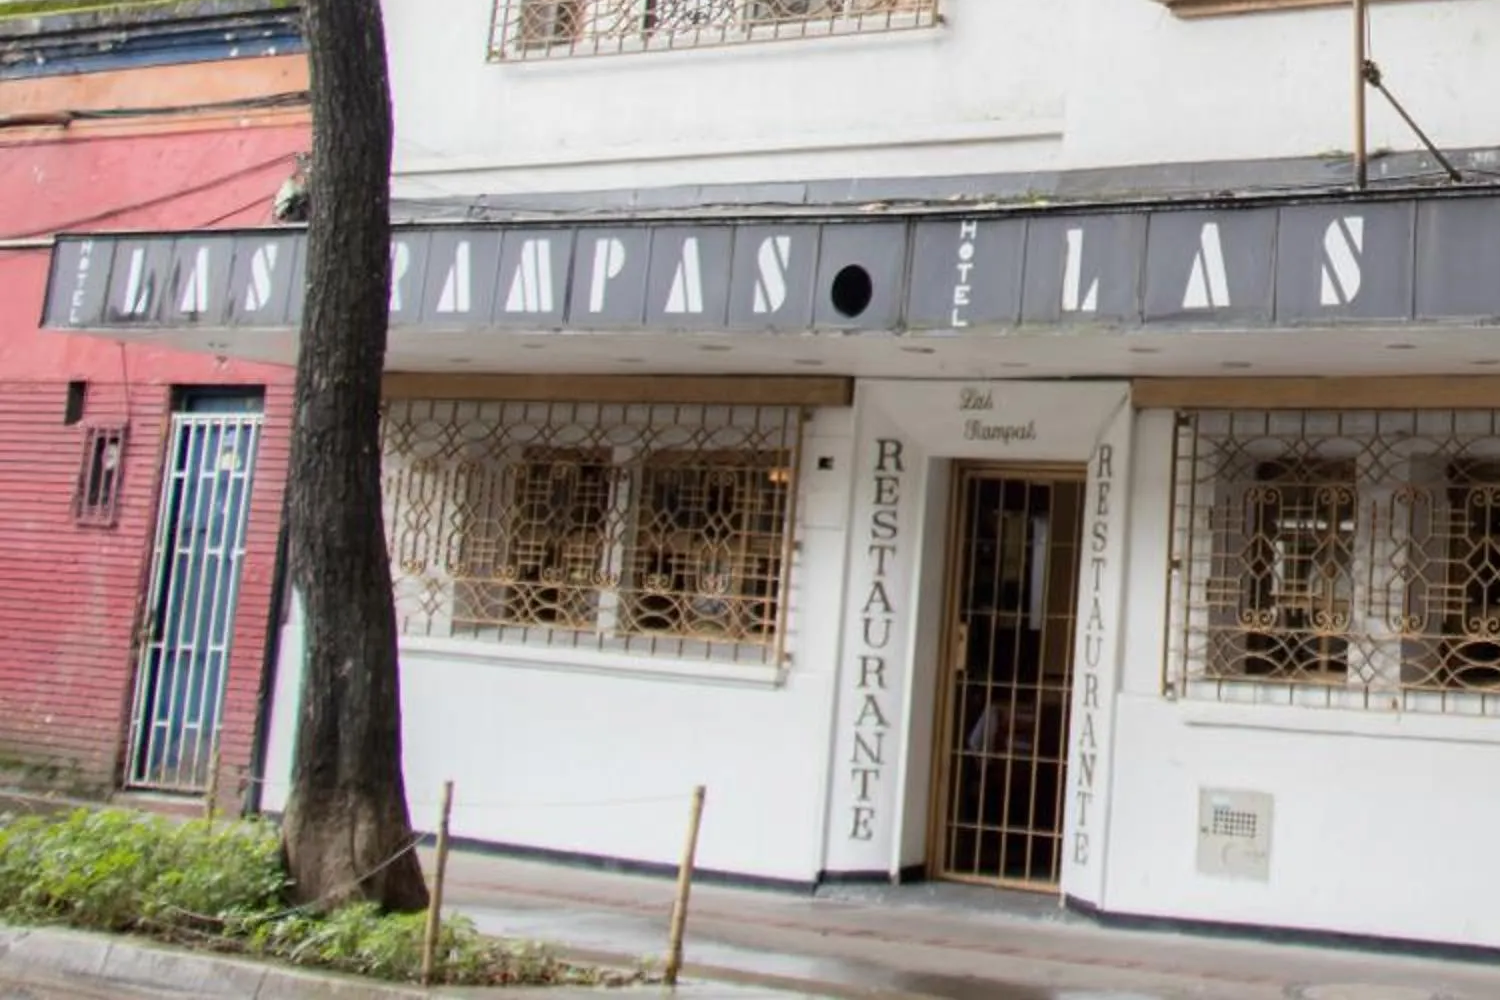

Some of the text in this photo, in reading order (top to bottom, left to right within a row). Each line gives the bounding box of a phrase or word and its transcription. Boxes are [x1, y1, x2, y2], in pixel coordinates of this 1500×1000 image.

[69, 239, 93, 324] HOTEL
[122, 244, 278, 314] LAS
[951, 219, 977, 328] HOTEL
[1062, 216, 1363, 313] LAS
[850, 438, 905, 842] RESTAURANTE
[1073, 444, 1113, 866] RESTAURANTE
